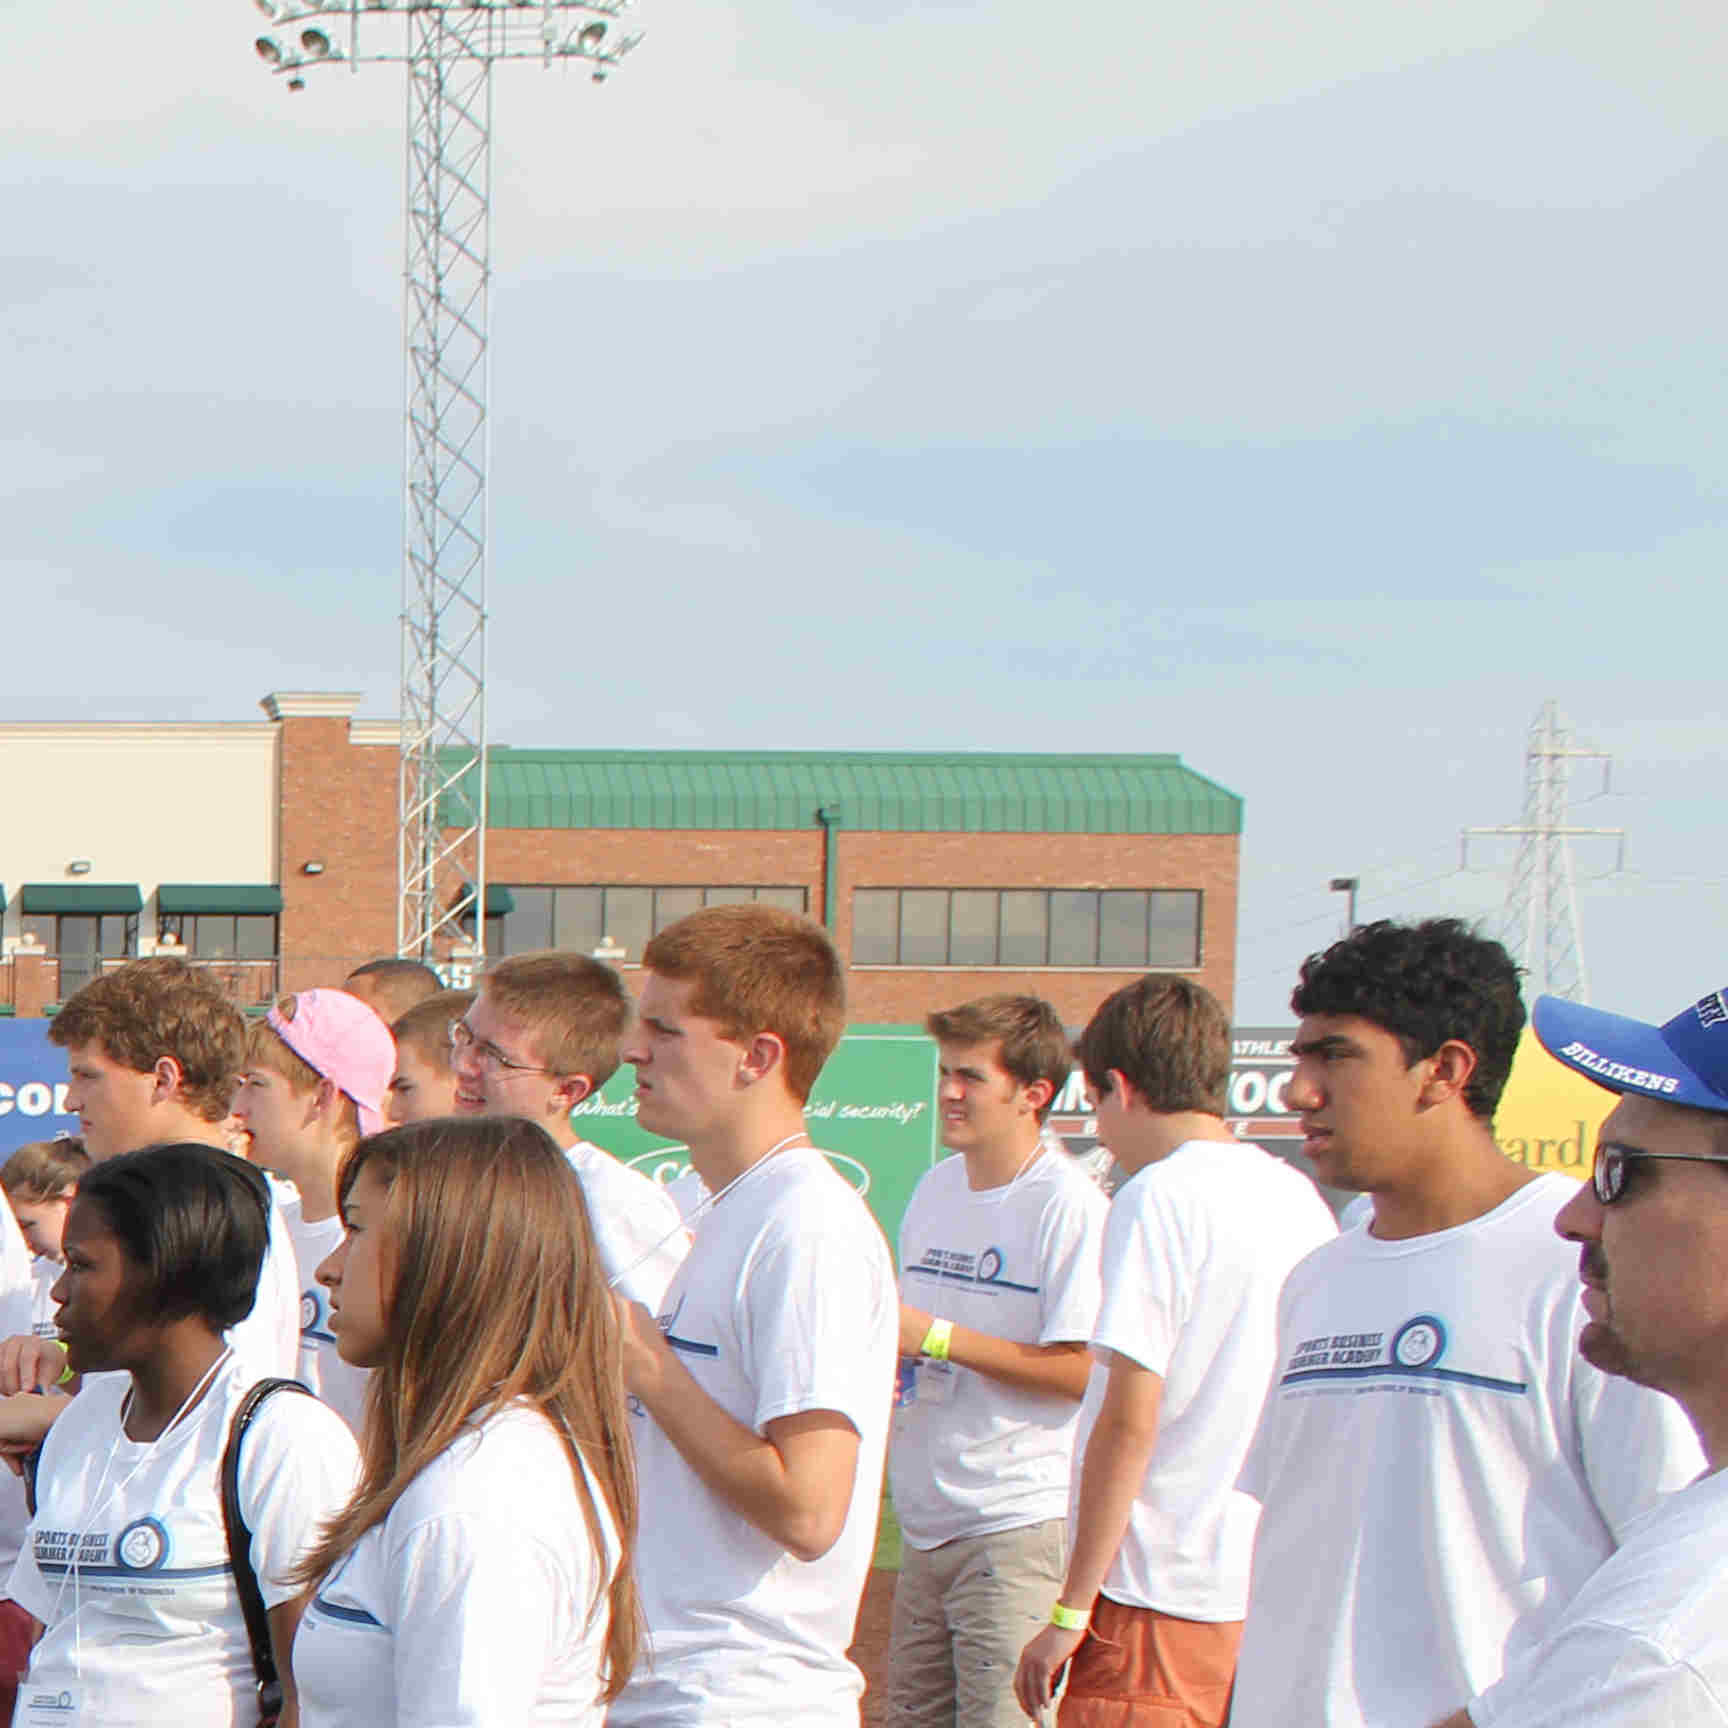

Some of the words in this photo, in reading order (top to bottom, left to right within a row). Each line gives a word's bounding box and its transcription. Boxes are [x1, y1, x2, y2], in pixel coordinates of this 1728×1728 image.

[1561, 1041, 1680, 1094] BILLIKENS
[839, 1098, 929, 1125] security?
[69, 1532, 110, 1547] BSINESS
[68, 1547, 109, 1563] AADEMY
